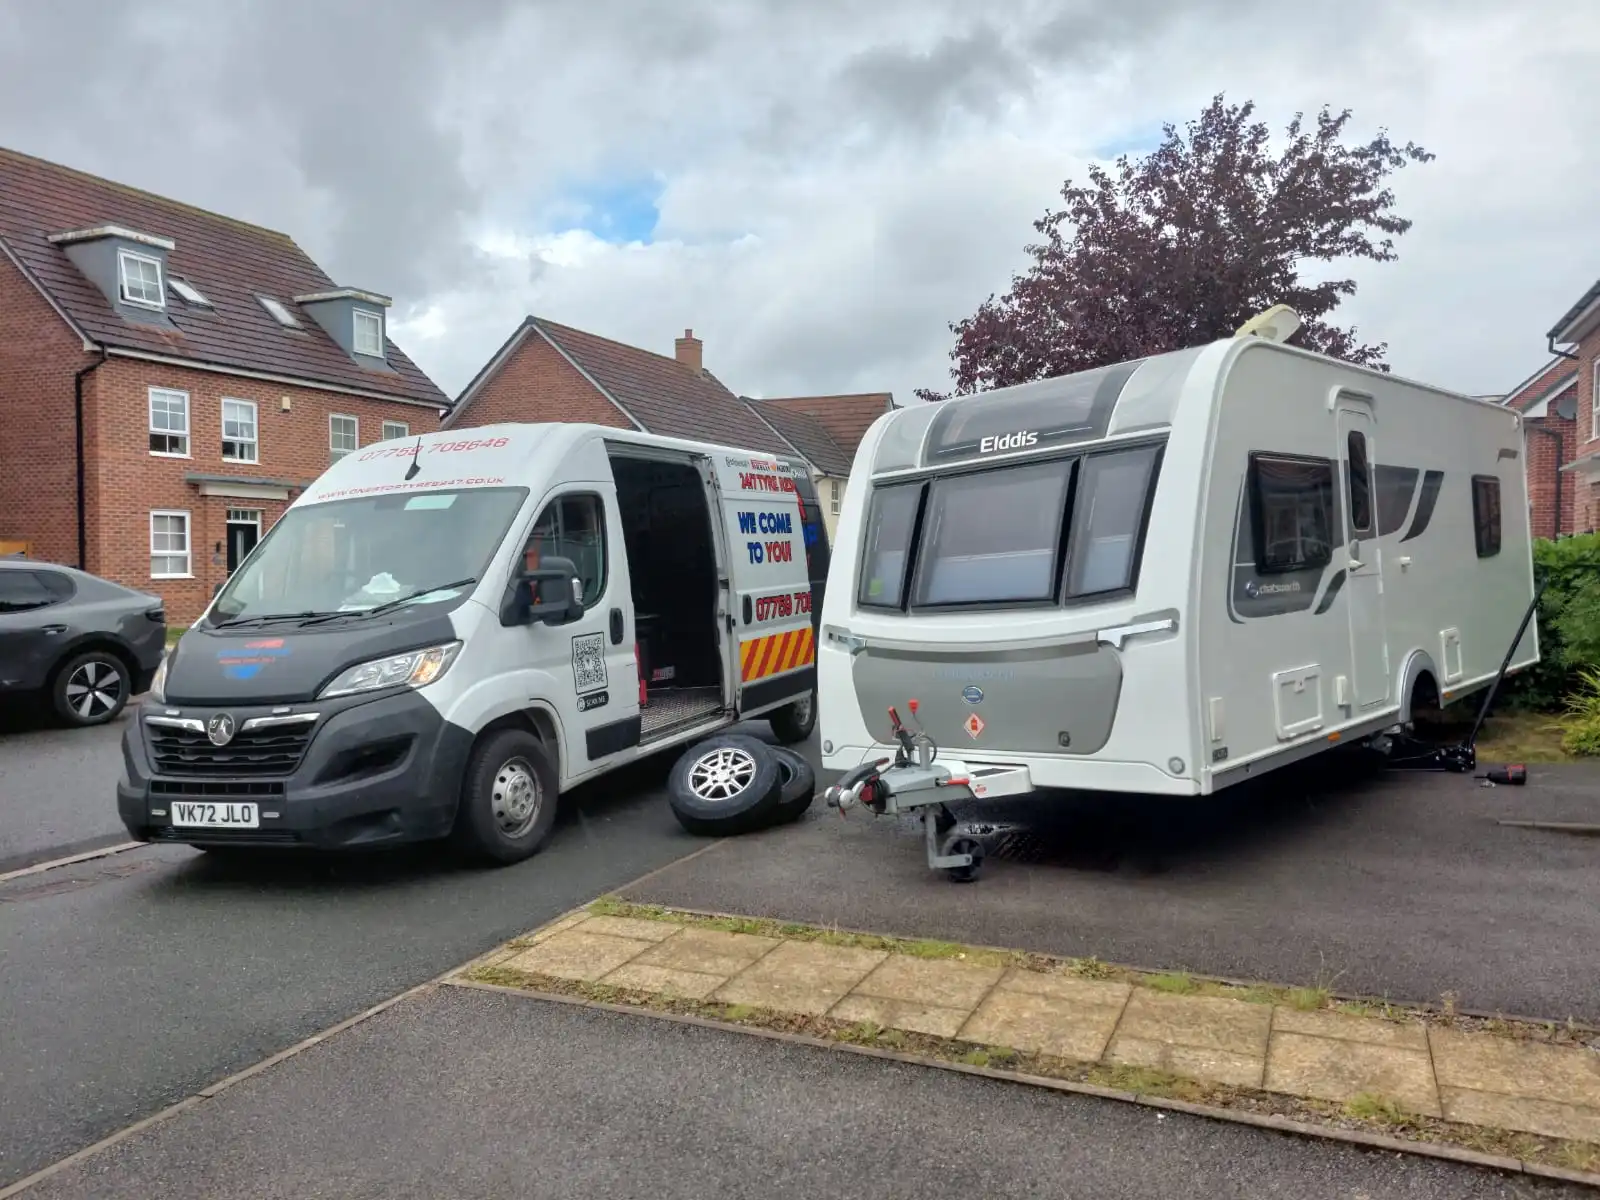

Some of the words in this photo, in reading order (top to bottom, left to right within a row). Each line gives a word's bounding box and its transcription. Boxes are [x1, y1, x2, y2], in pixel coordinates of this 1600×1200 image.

[980, 430, 1038, 453] Elddis
[738, 511, 756, 534] WE
[758, 512, 792, 534] COME
[747, 541, 764, 564] TO
[178, 804, 216, 822] VK72
[220, 804, 252, 823] JLO
